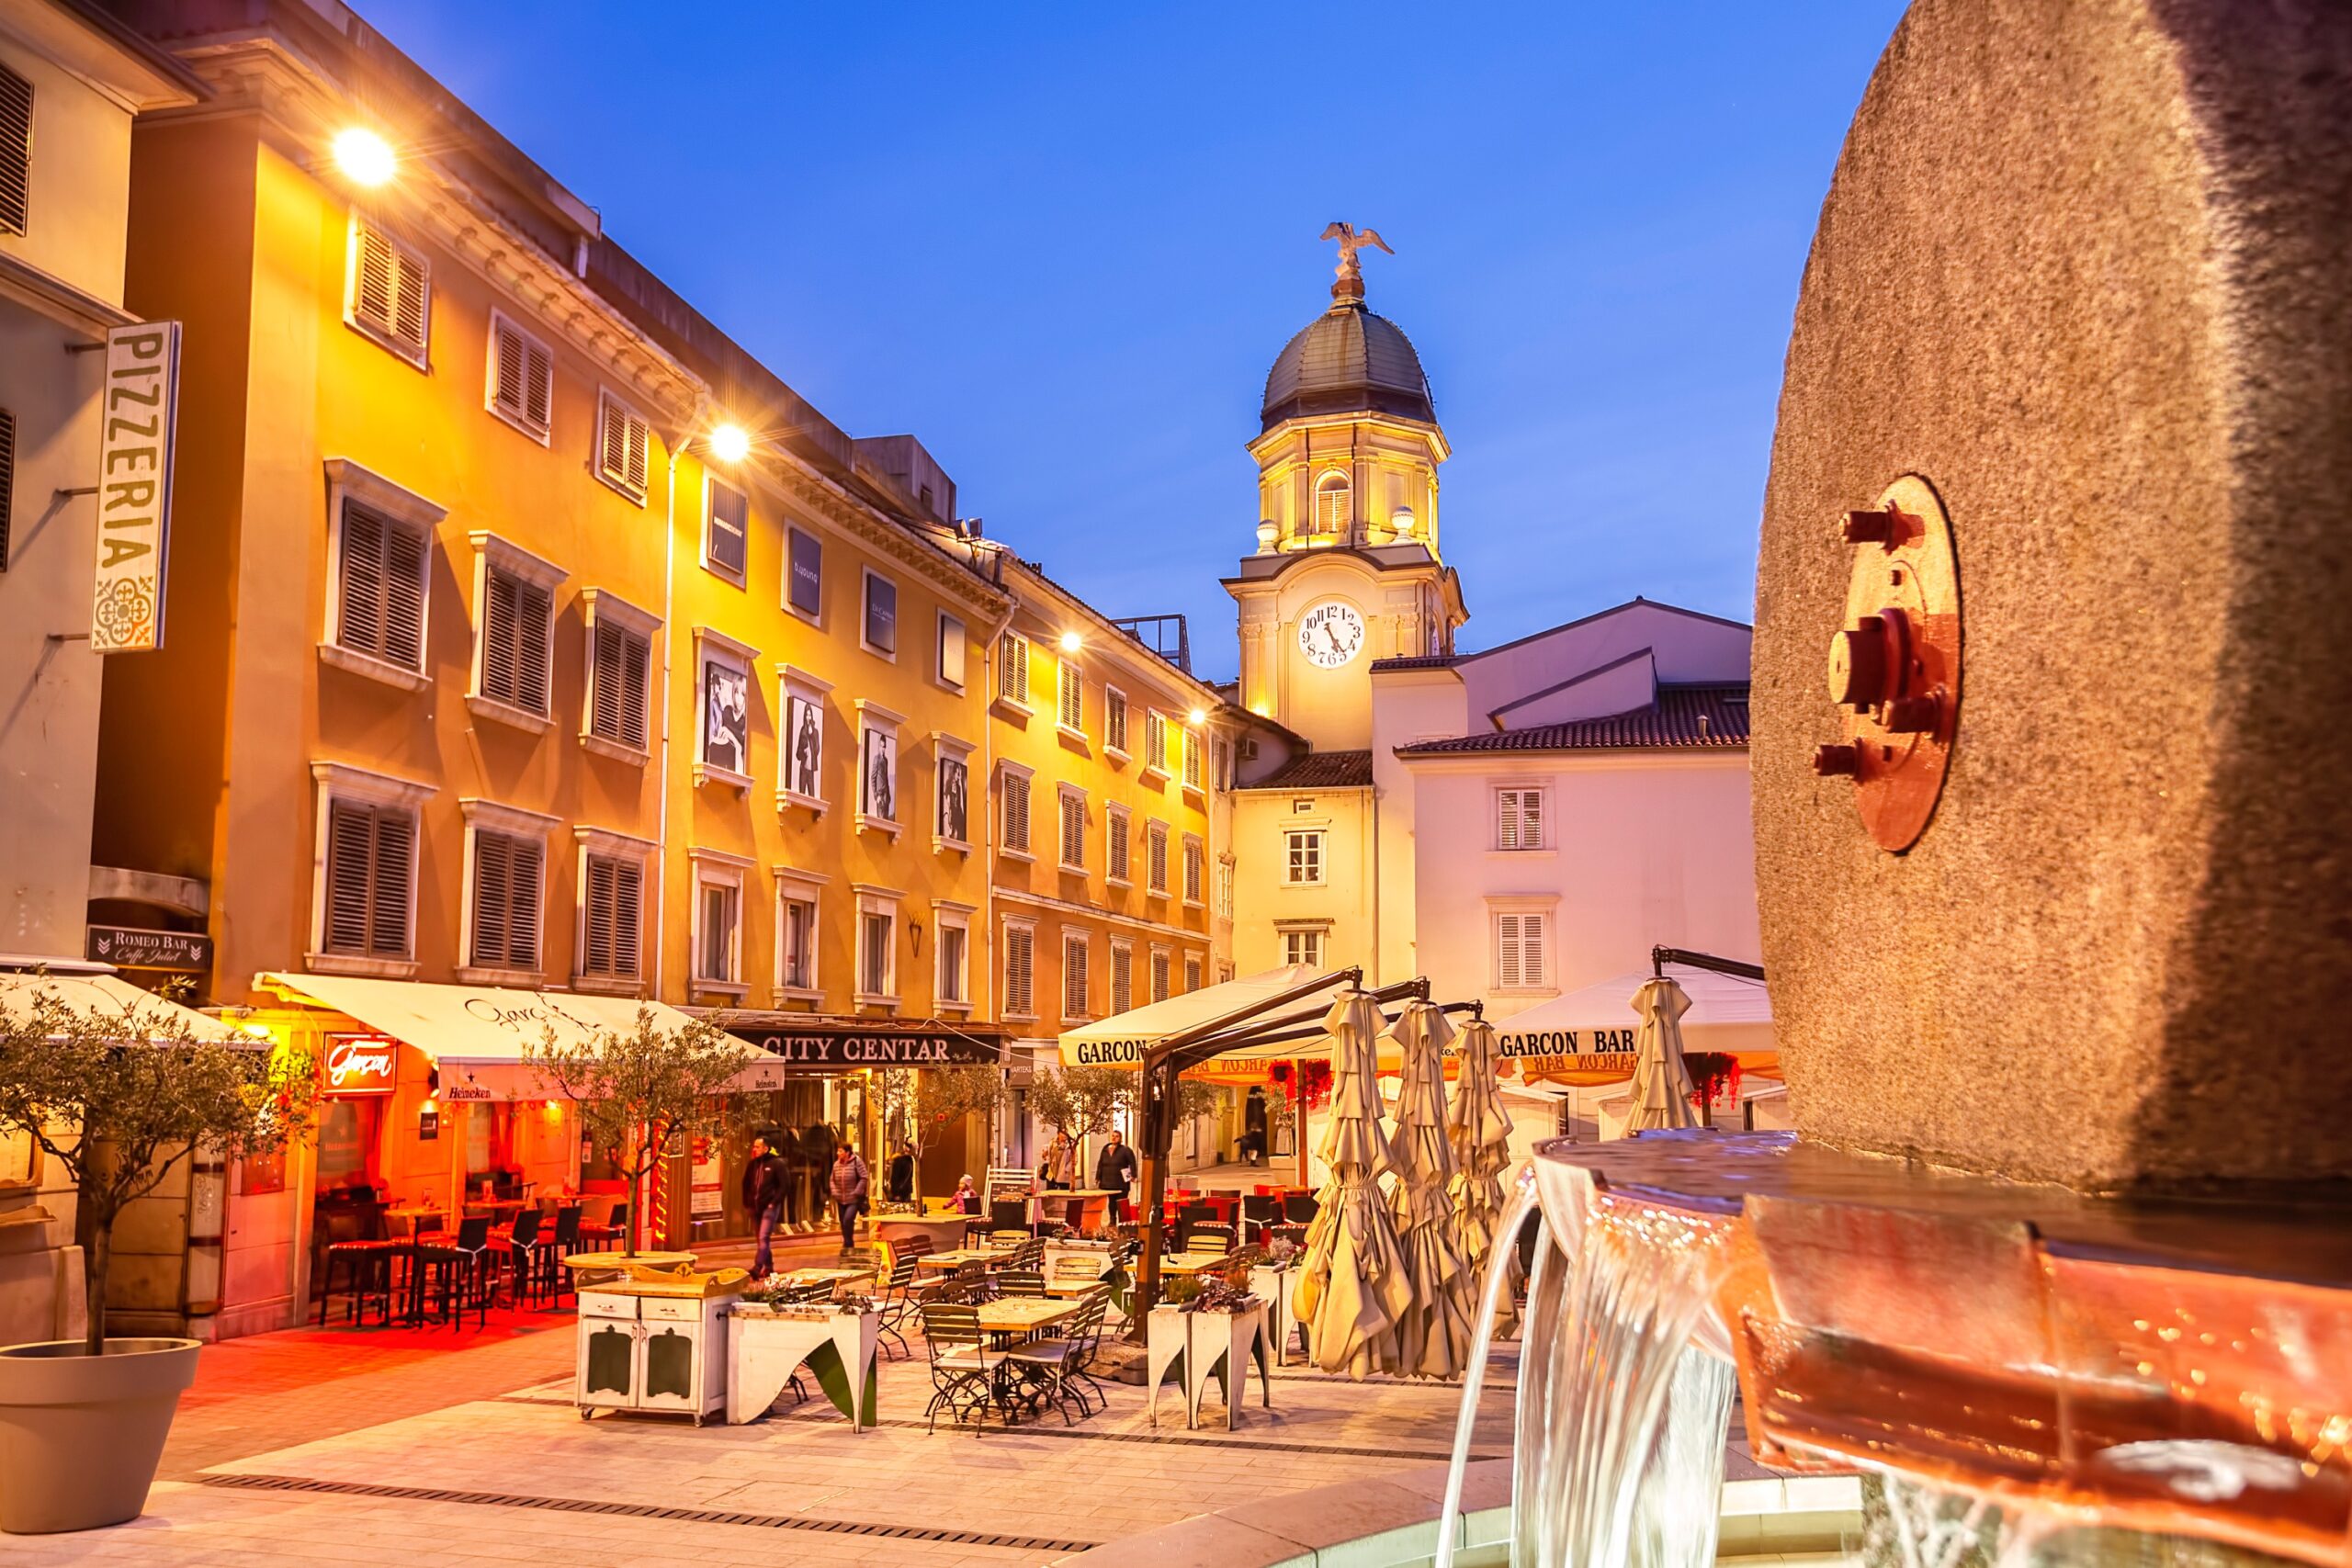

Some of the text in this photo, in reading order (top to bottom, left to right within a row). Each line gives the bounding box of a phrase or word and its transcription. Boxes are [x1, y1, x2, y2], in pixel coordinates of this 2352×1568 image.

[101, 332, 164, 569] PIZZERIA
[1317, 609, 1324, 622] 11
[1327, 605, 1338, 618] 12
[1342, 608, 1345, 620] 1
[1306, 616, 1317, 629] 10
[1348, 614, 1354, 626] 2
[1302, 631, 1310, 644] 9
[1352, 626, 1361, 638] 3
[1307, 643, 1316, 657] 8
[1348, 639, 1355, 651] 4
[1318, 651, 1326, 663] 7
[1328, 652, 1336, 665] 6
[763, 1037, 950, 1061] CITY CENTAR
[1500, 1030, 1635, 1057] GARCON BAR
[1077, 1039, 1147, 1065] GARCON
[448, 1087, 491, 1100] Heineken
